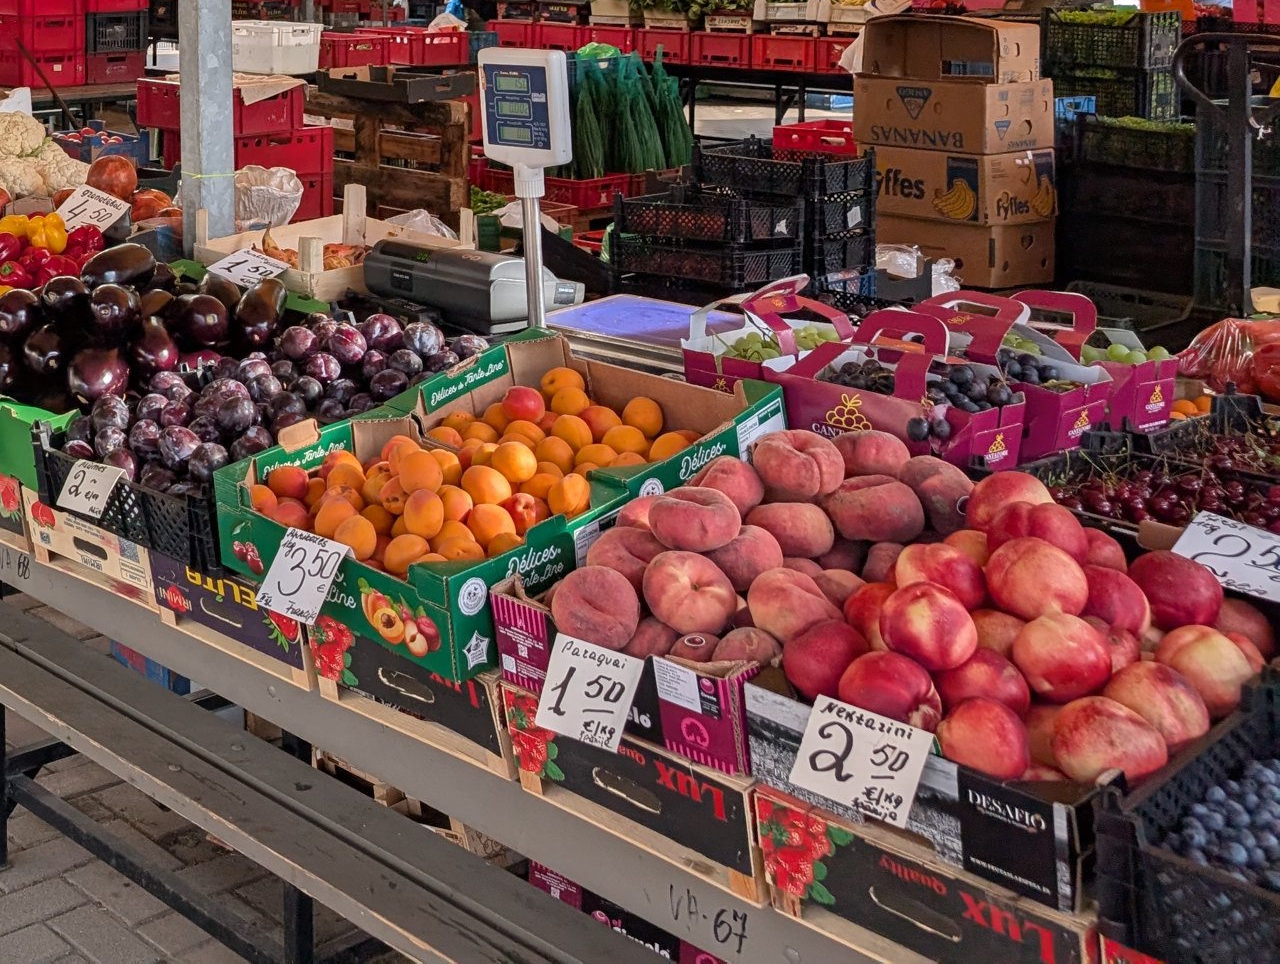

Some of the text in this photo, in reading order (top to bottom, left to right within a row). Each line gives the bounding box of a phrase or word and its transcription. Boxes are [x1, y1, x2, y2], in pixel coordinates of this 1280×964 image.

[871, 124, 964, 149] BANANAS
[874, 167, 925, 200] yffes
[66, 199, 113, 223] 4 50
[219, 259, 249, 273] 1
[247, 265, 274, 276] 50
[679, 441, 726, 480] Délices
[67, 469, 86, 498] 2
[277, 547, 341, 596] 3 50
[506, 544, 562, 580] Délices
[1190, 534, 1280, 577] 2 5
[156, 586, 193, 611] IRMINI
[185, 565, 258, 611] ELITA
[326, 585, 357, 609] Line
[547, 666, 577, 716] 1
[584, 674, 626, 704] 50
[820, 700, 914, 741] Nektarini
[808, 721, 910, 782] 2 50
[653, 758, 728, 824] Lux
[967, 788, 1047, 832] DESAFIO
[879, 853, 949, 896] Quality
[959, 890, 1057, 964] Lux
